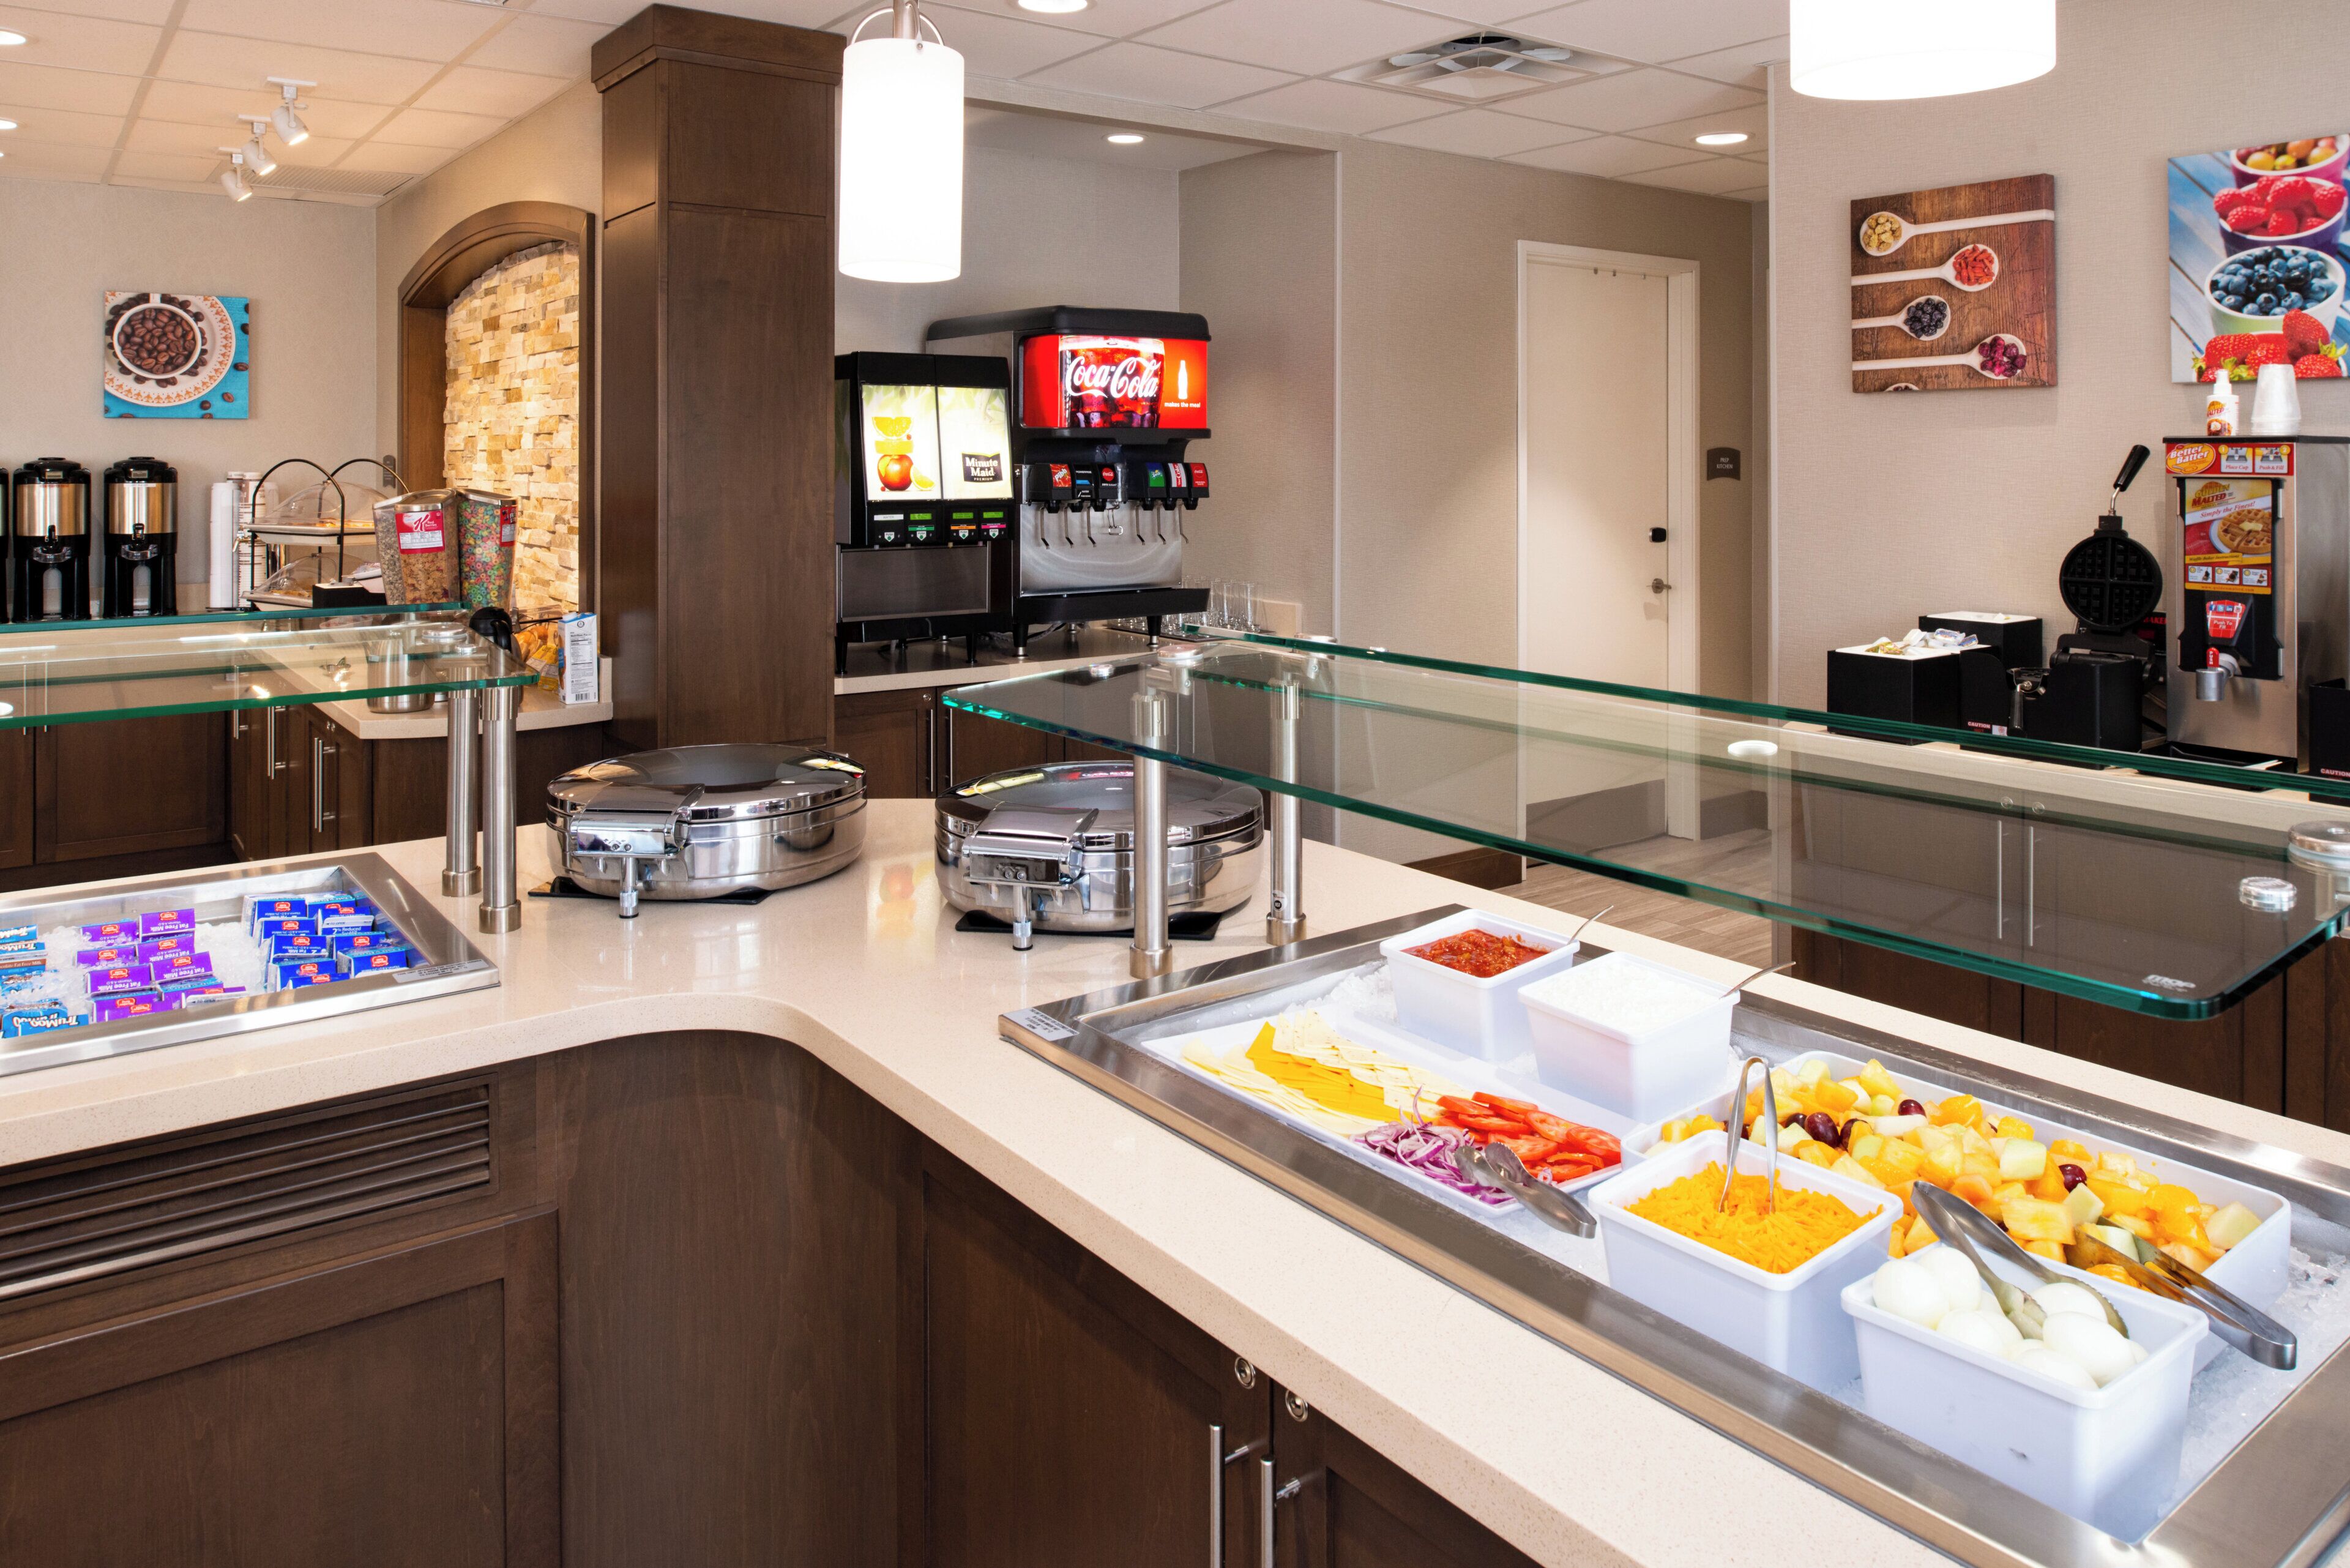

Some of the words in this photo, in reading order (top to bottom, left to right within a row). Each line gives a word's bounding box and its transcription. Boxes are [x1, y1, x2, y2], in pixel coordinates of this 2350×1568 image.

[1065, 356, 1162, 398] Coca-Cola
[2170, 445, 2203, 459] Better
[2176, 450, 2210, 465] Batter
[965, 457, 998, 467] Minute
[971, 467, 995, 476] Maid
[1054, 468, 1067, 482] Pibb
[2195, 483, 2229, 498] GOLDEN
[2192, 493, 2226, 507] MALTED
[2200, 508, 2221, 518] Simply
[2223, 505, 2232, 513] the
[2234, 501, 2256, 511] Finest!
[414, 513, 431, 532] K
[29, 1015, 78, 1028] TruMoo
